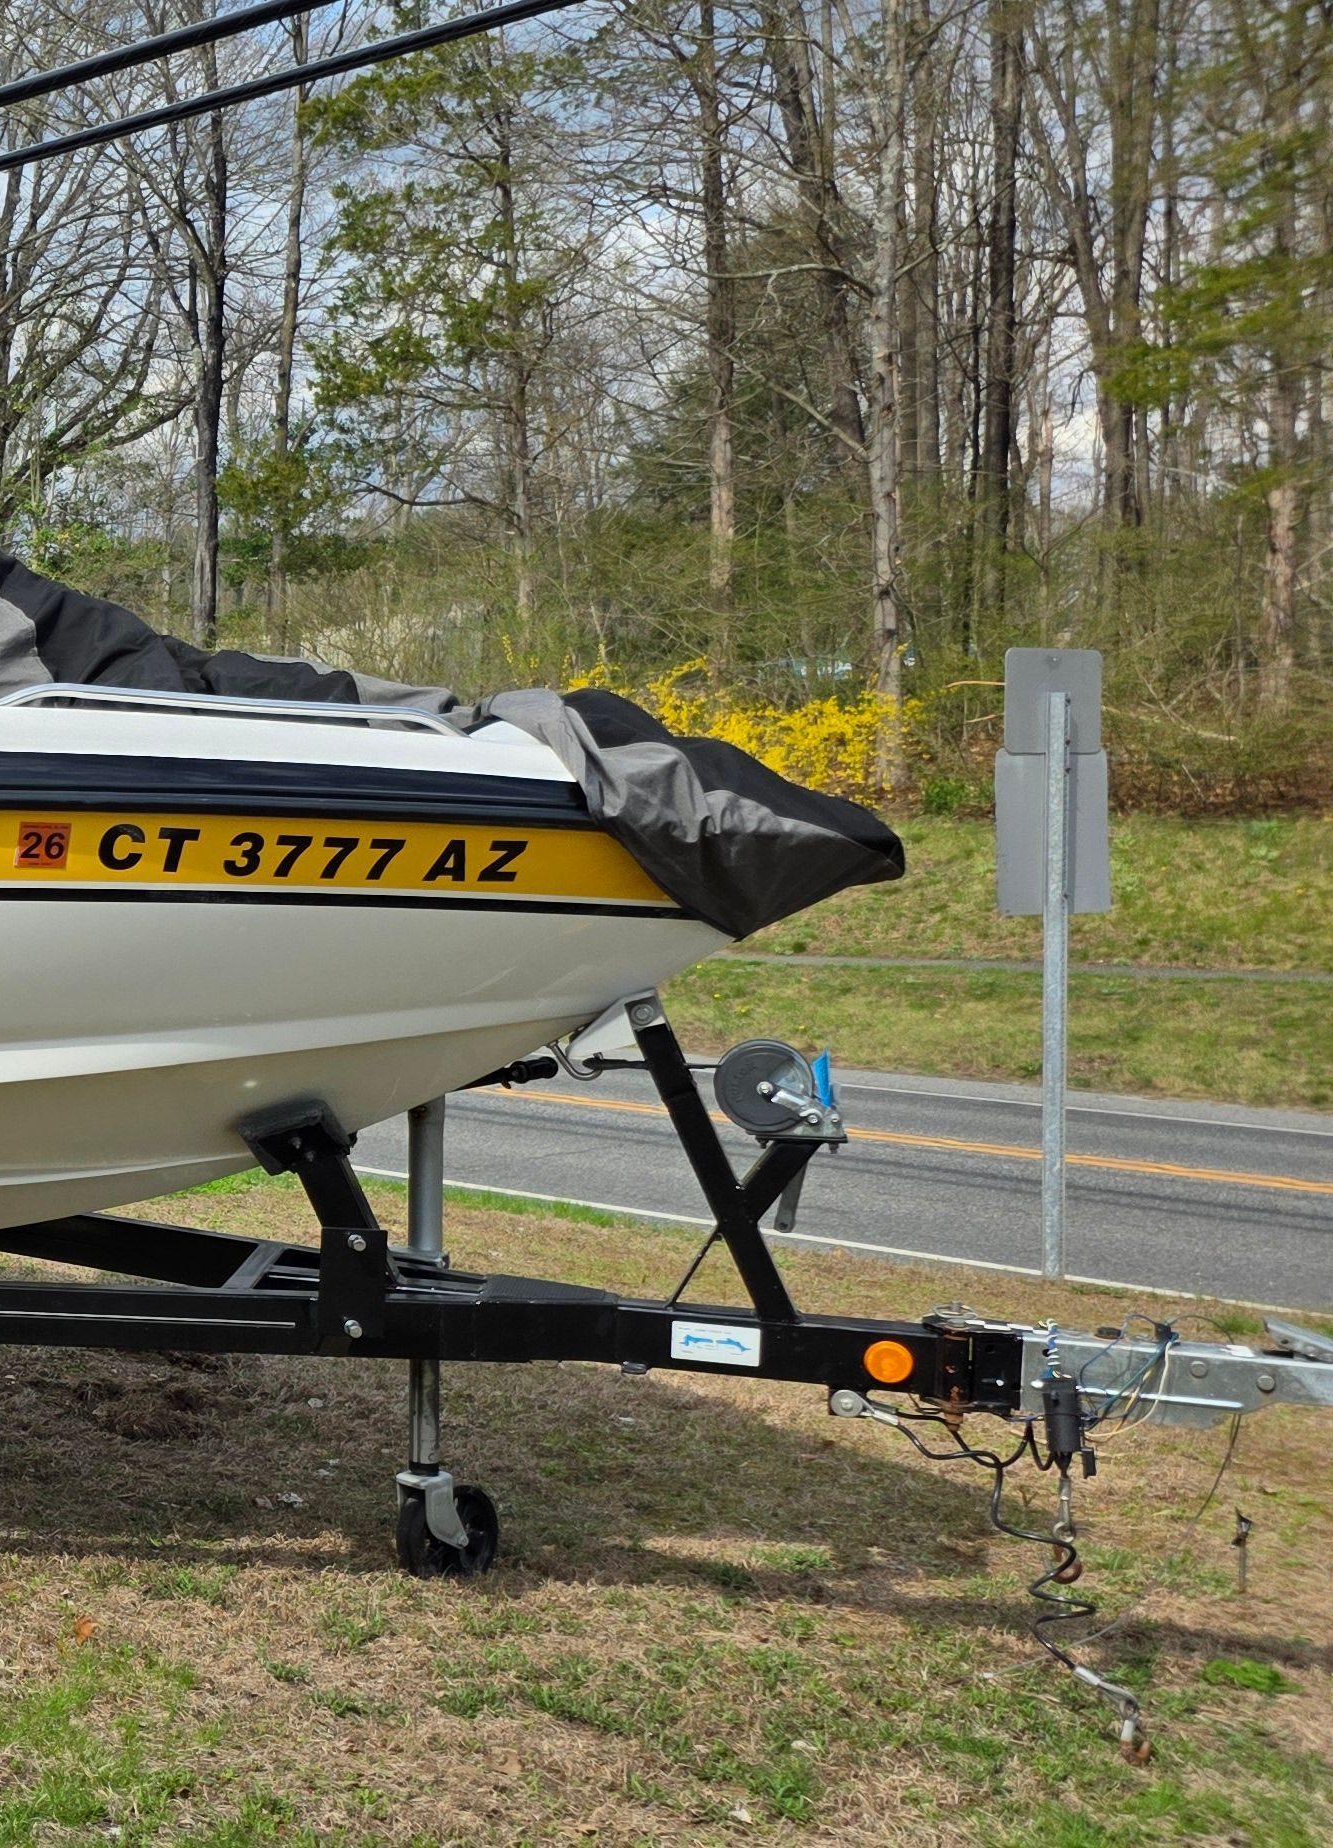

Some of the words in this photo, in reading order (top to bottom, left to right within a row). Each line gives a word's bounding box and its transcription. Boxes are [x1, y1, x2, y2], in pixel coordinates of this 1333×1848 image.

[20, 832, 66, 859] 26
[98, 824, 201, 873] CT
[223, 832, 407, 881] 3777
[422, 839, 529, 882] AZ
